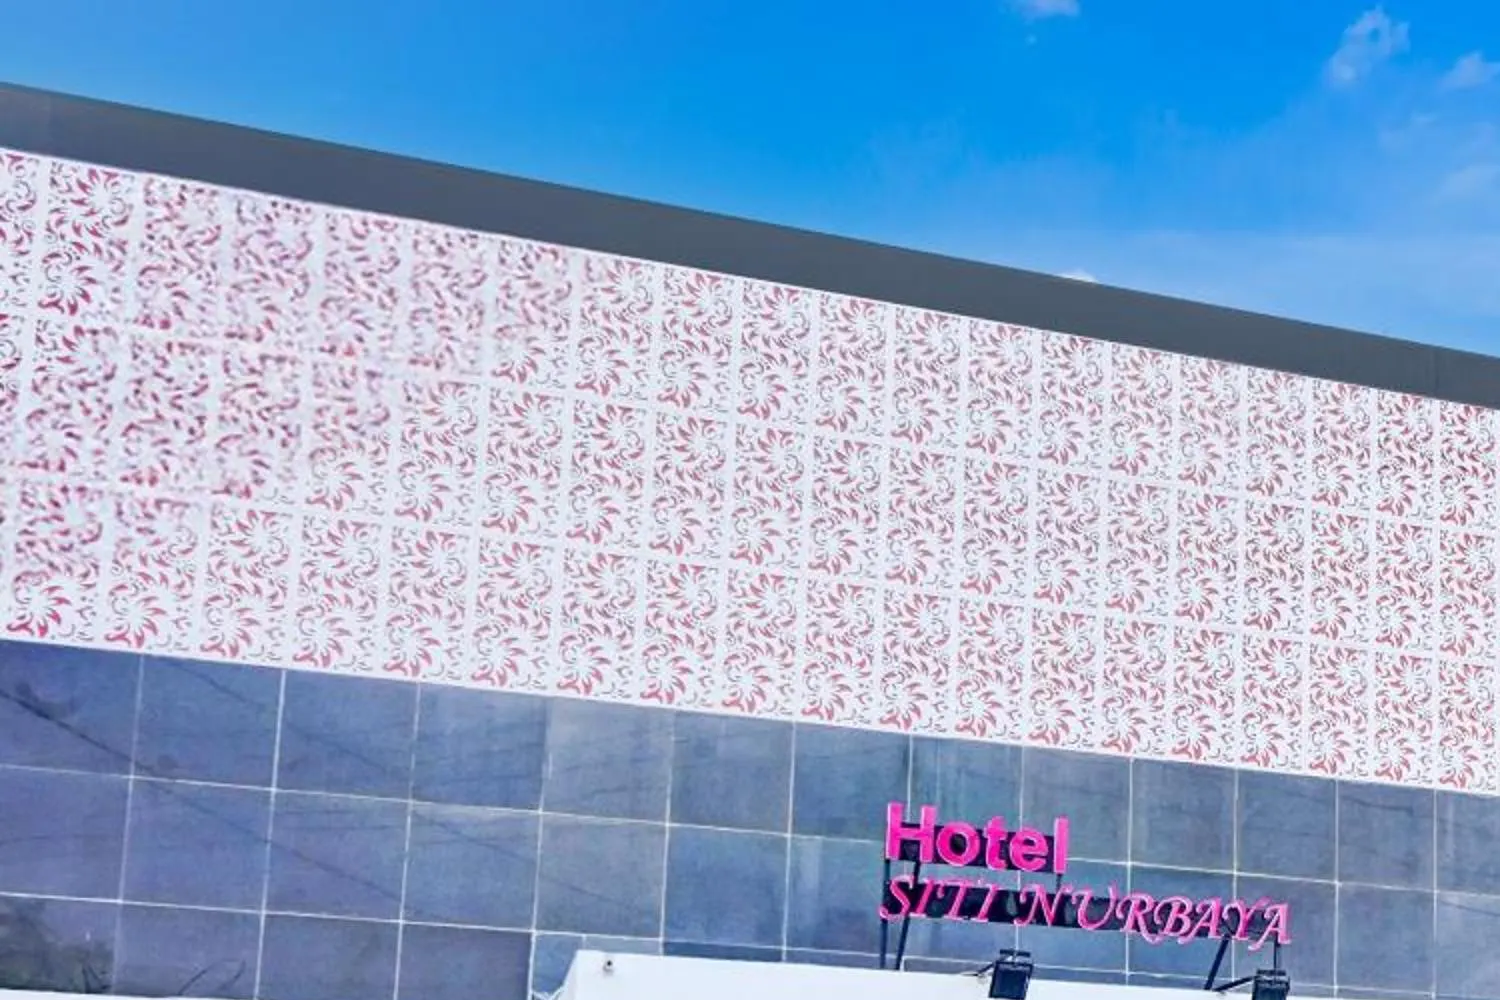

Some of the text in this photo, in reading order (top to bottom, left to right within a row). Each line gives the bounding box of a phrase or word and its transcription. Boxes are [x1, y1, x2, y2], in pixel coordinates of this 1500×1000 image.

[886, 802, 1069, 874] Hotel
[880, 875, 1292, 950] SITI NURBAYA
